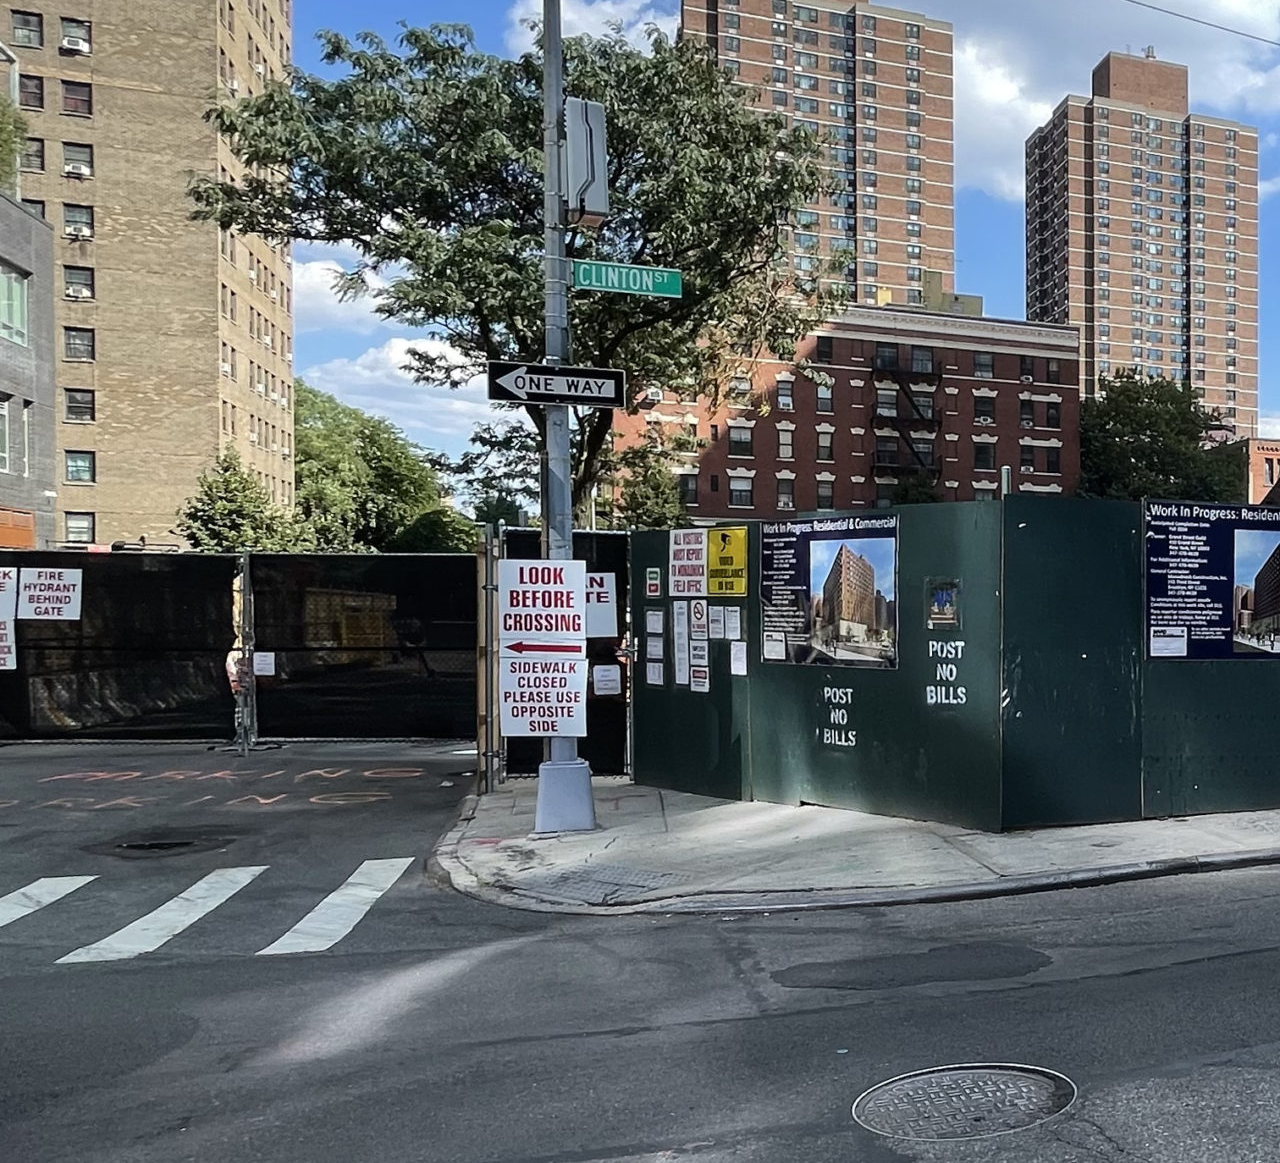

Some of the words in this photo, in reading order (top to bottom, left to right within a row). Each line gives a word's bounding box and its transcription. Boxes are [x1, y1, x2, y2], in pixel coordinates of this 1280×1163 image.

[579, 265, 653, 291] CLINTON
[654, 272, 669, 284] ST
[514, 376, 554, 391] ONE
[566, 379, 606, 394] WAY
[1150, 504, 1178, 516] Work
[1181, 506, 1190, 517] In
[1193, 507, 1239, 520] Progress:
[763, 523, 779, 534] Work
[813, 519, 848, 531] Residential
[849, 518, 854, 529] &
[855, 516, 896, 529] Commercial
[37, 571, 64, 581] FIRE
[519, 567, 565, 585] LOOK
[23, 583, 78, 593] HYDRANT
[28, 594, 72, 605] BEHIND
[509, 590, 575, 609] BEFORE
[34, 606, 64, 616] GATE
[503, 613, 582, 632] CROSSING
[928, 641, 965, 659] POST
[510, 662, 577, 674] SIDEWALK
[936, 663, 957, 681] NO
[518, 677, 567, 689] CLOSED
[504, 691, 552, 703] PLEASE
[556, 691, 581, 703] USE
[823, 687, 854, 704] POST
[926, 685, 967, 706] BILLS
[511, 705, 575, 718] OPPOSITE
[830, 708, 848, 725] NO
[529, 720, 559, 732] SIDE
[823, 727, 857, 747] BILLS
